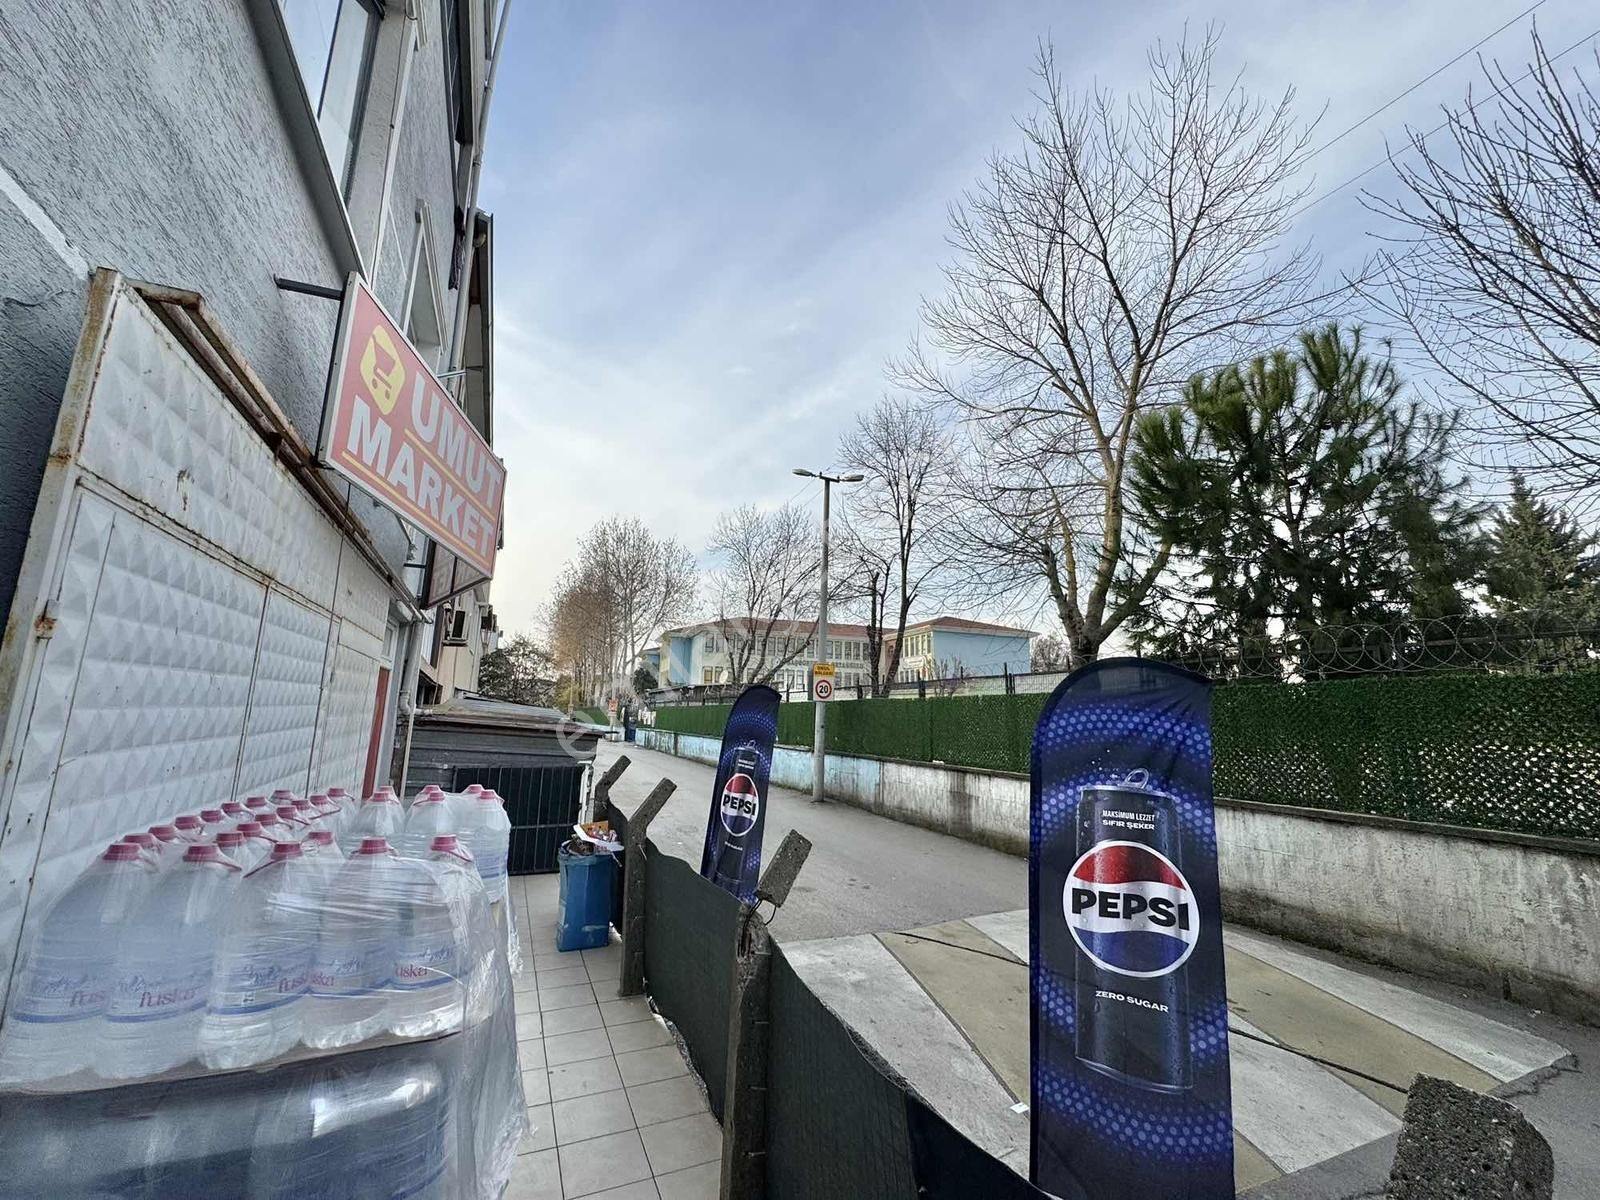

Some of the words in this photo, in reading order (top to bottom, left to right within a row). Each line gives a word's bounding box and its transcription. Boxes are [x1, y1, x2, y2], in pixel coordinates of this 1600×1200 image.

[411, 371, 500, 506] UMUT
[347, 395, 494, 557] MARKET
[819, 685, 829, 694] 20
[722, 793, 757, 817] PEPSI
[1135, 812, 1155, 822] LEZZET
[1102, 819, 1125, 828] SIFIR
[1126, 821, 1155, 831] ŞEKER
[1071, 887, 1191, 932] PEPSI
[1095, 990, 1126, 1001] ZERO
[1126, 996, 1169, 1014] SUGAR
